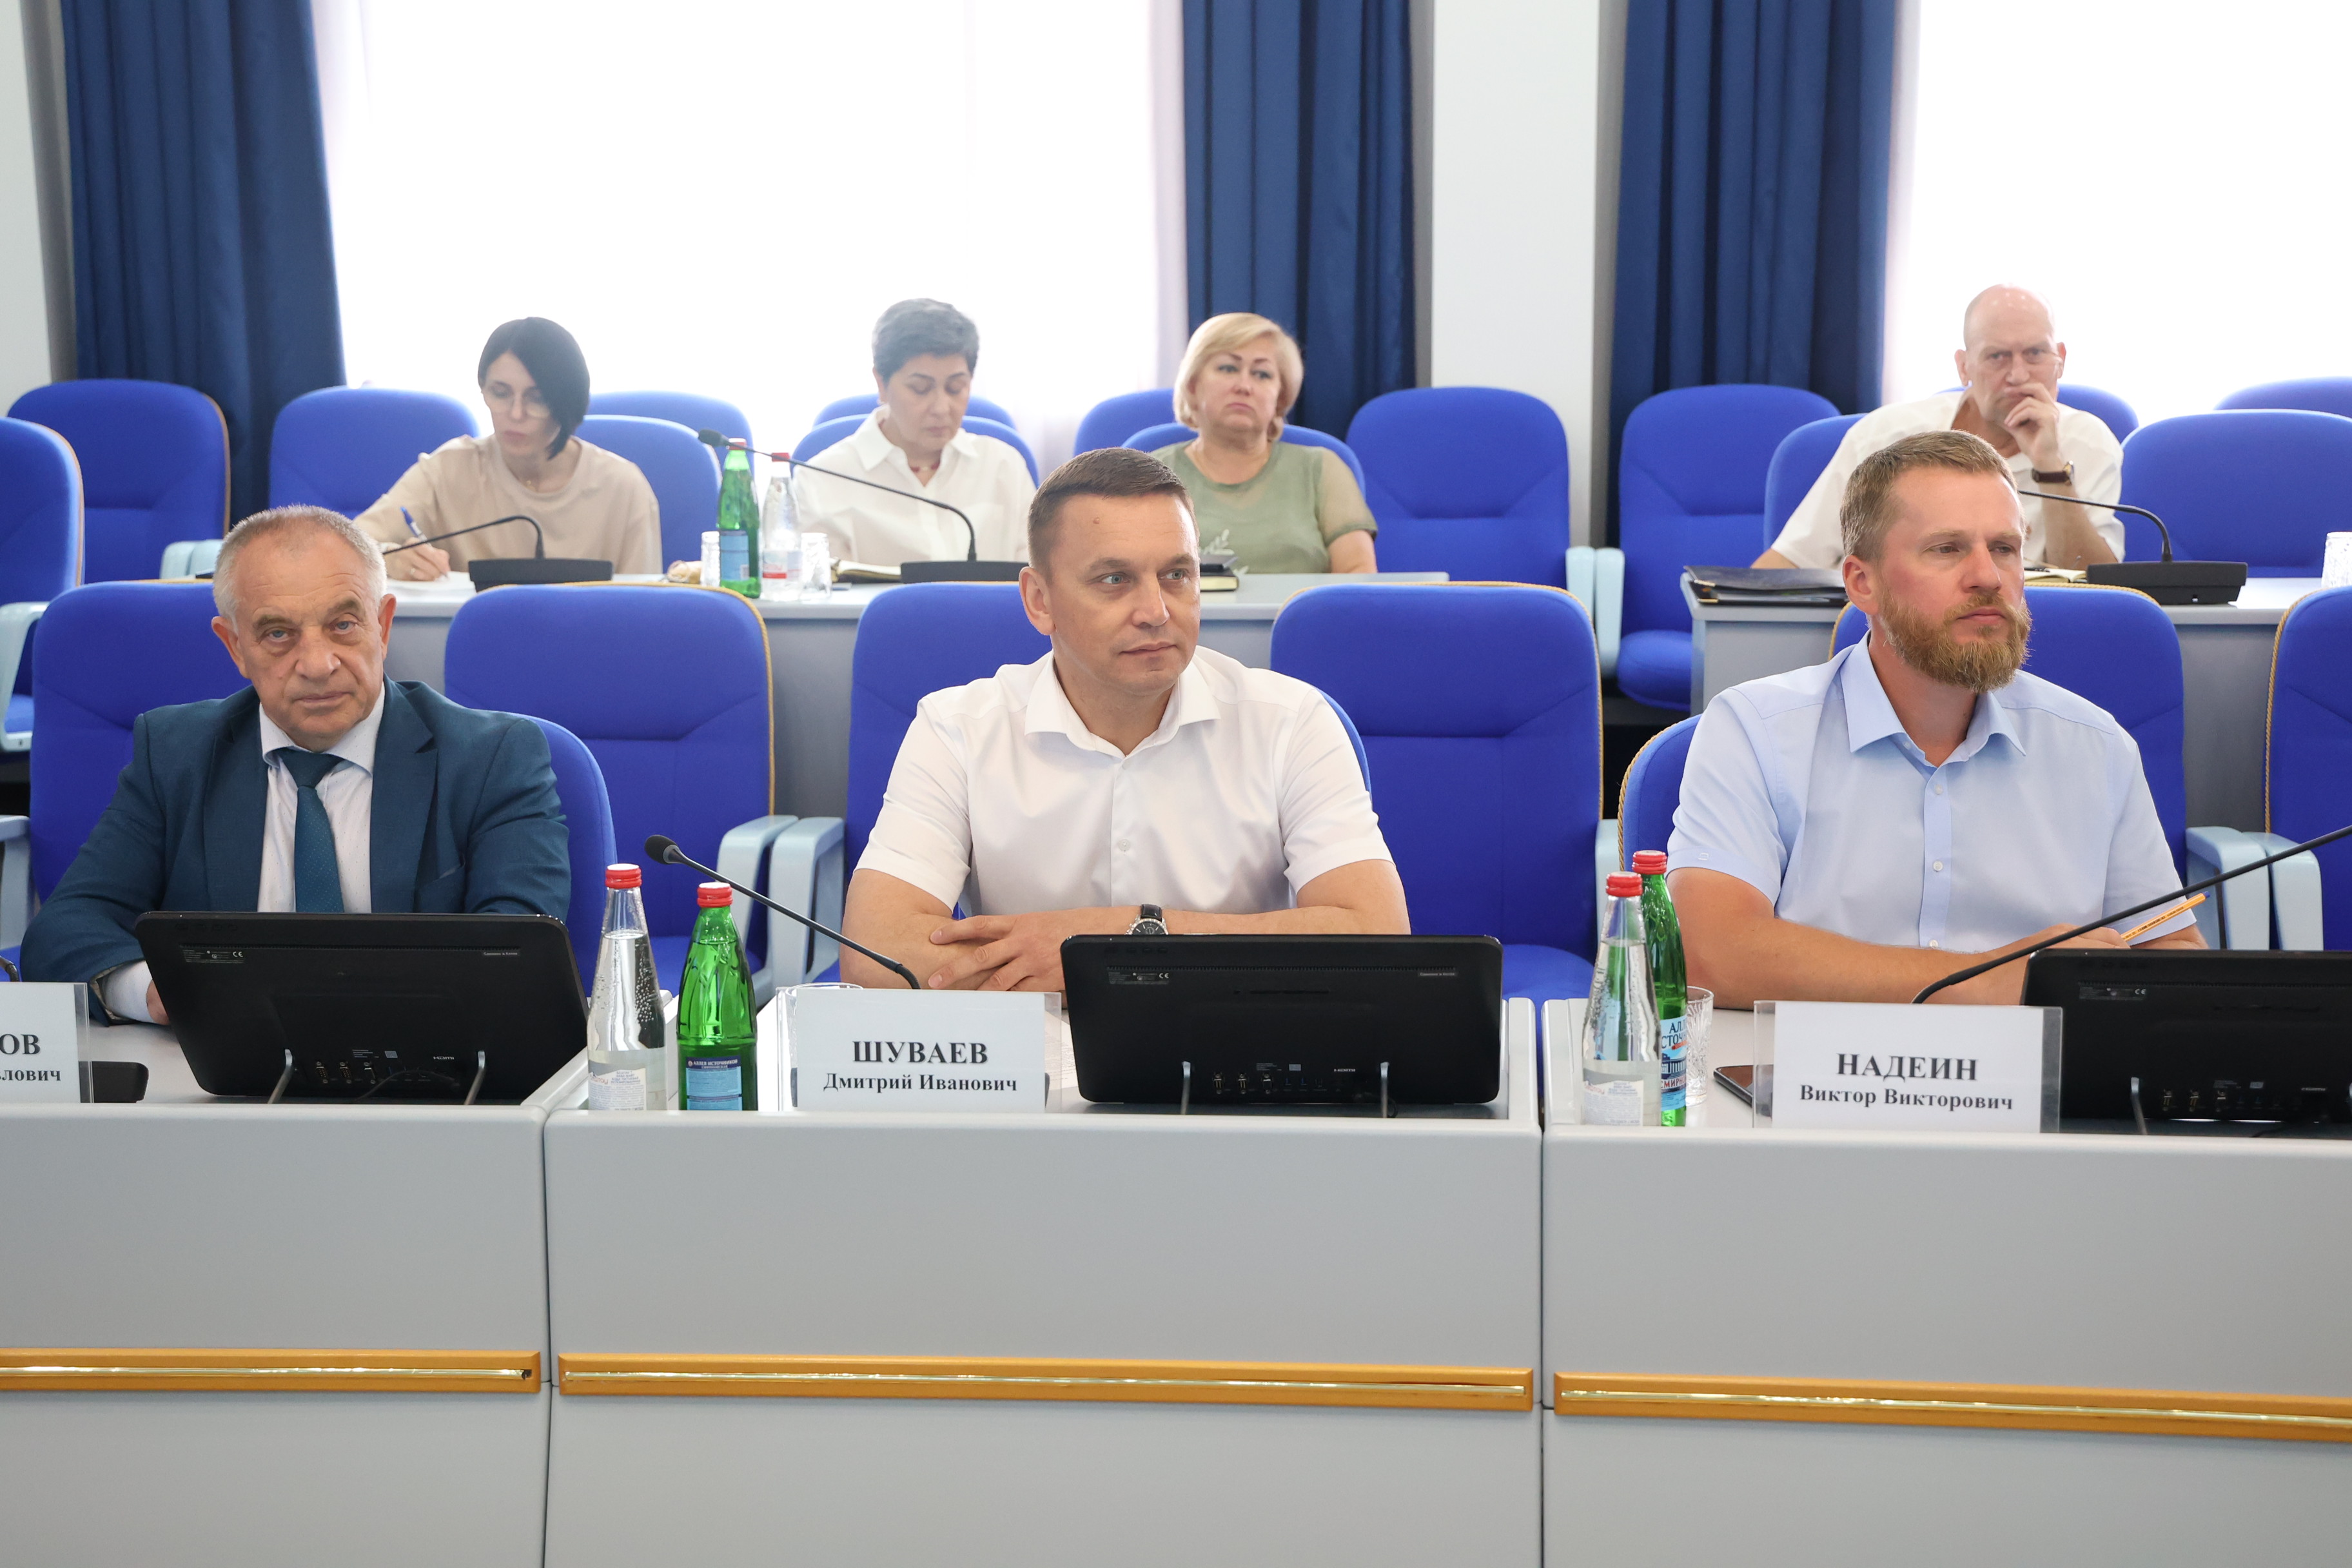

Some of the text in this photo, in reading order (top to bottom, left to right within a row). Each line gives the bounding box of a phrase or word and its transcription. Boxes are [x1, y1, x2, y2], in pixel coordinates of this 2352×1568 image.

[0, 1034, 41, 1055] ОВ
[852, 1041, 988, 1064] ШУВАЕВ
[0, 1070, 61, 1081] лович
[1836, 1053, 1979, 1083] НАДЕИН
[823, 1073, 1017, 1093] Дмитрий Иванович
[1800, 1084, 2013, 1112] Виктор Викторович
